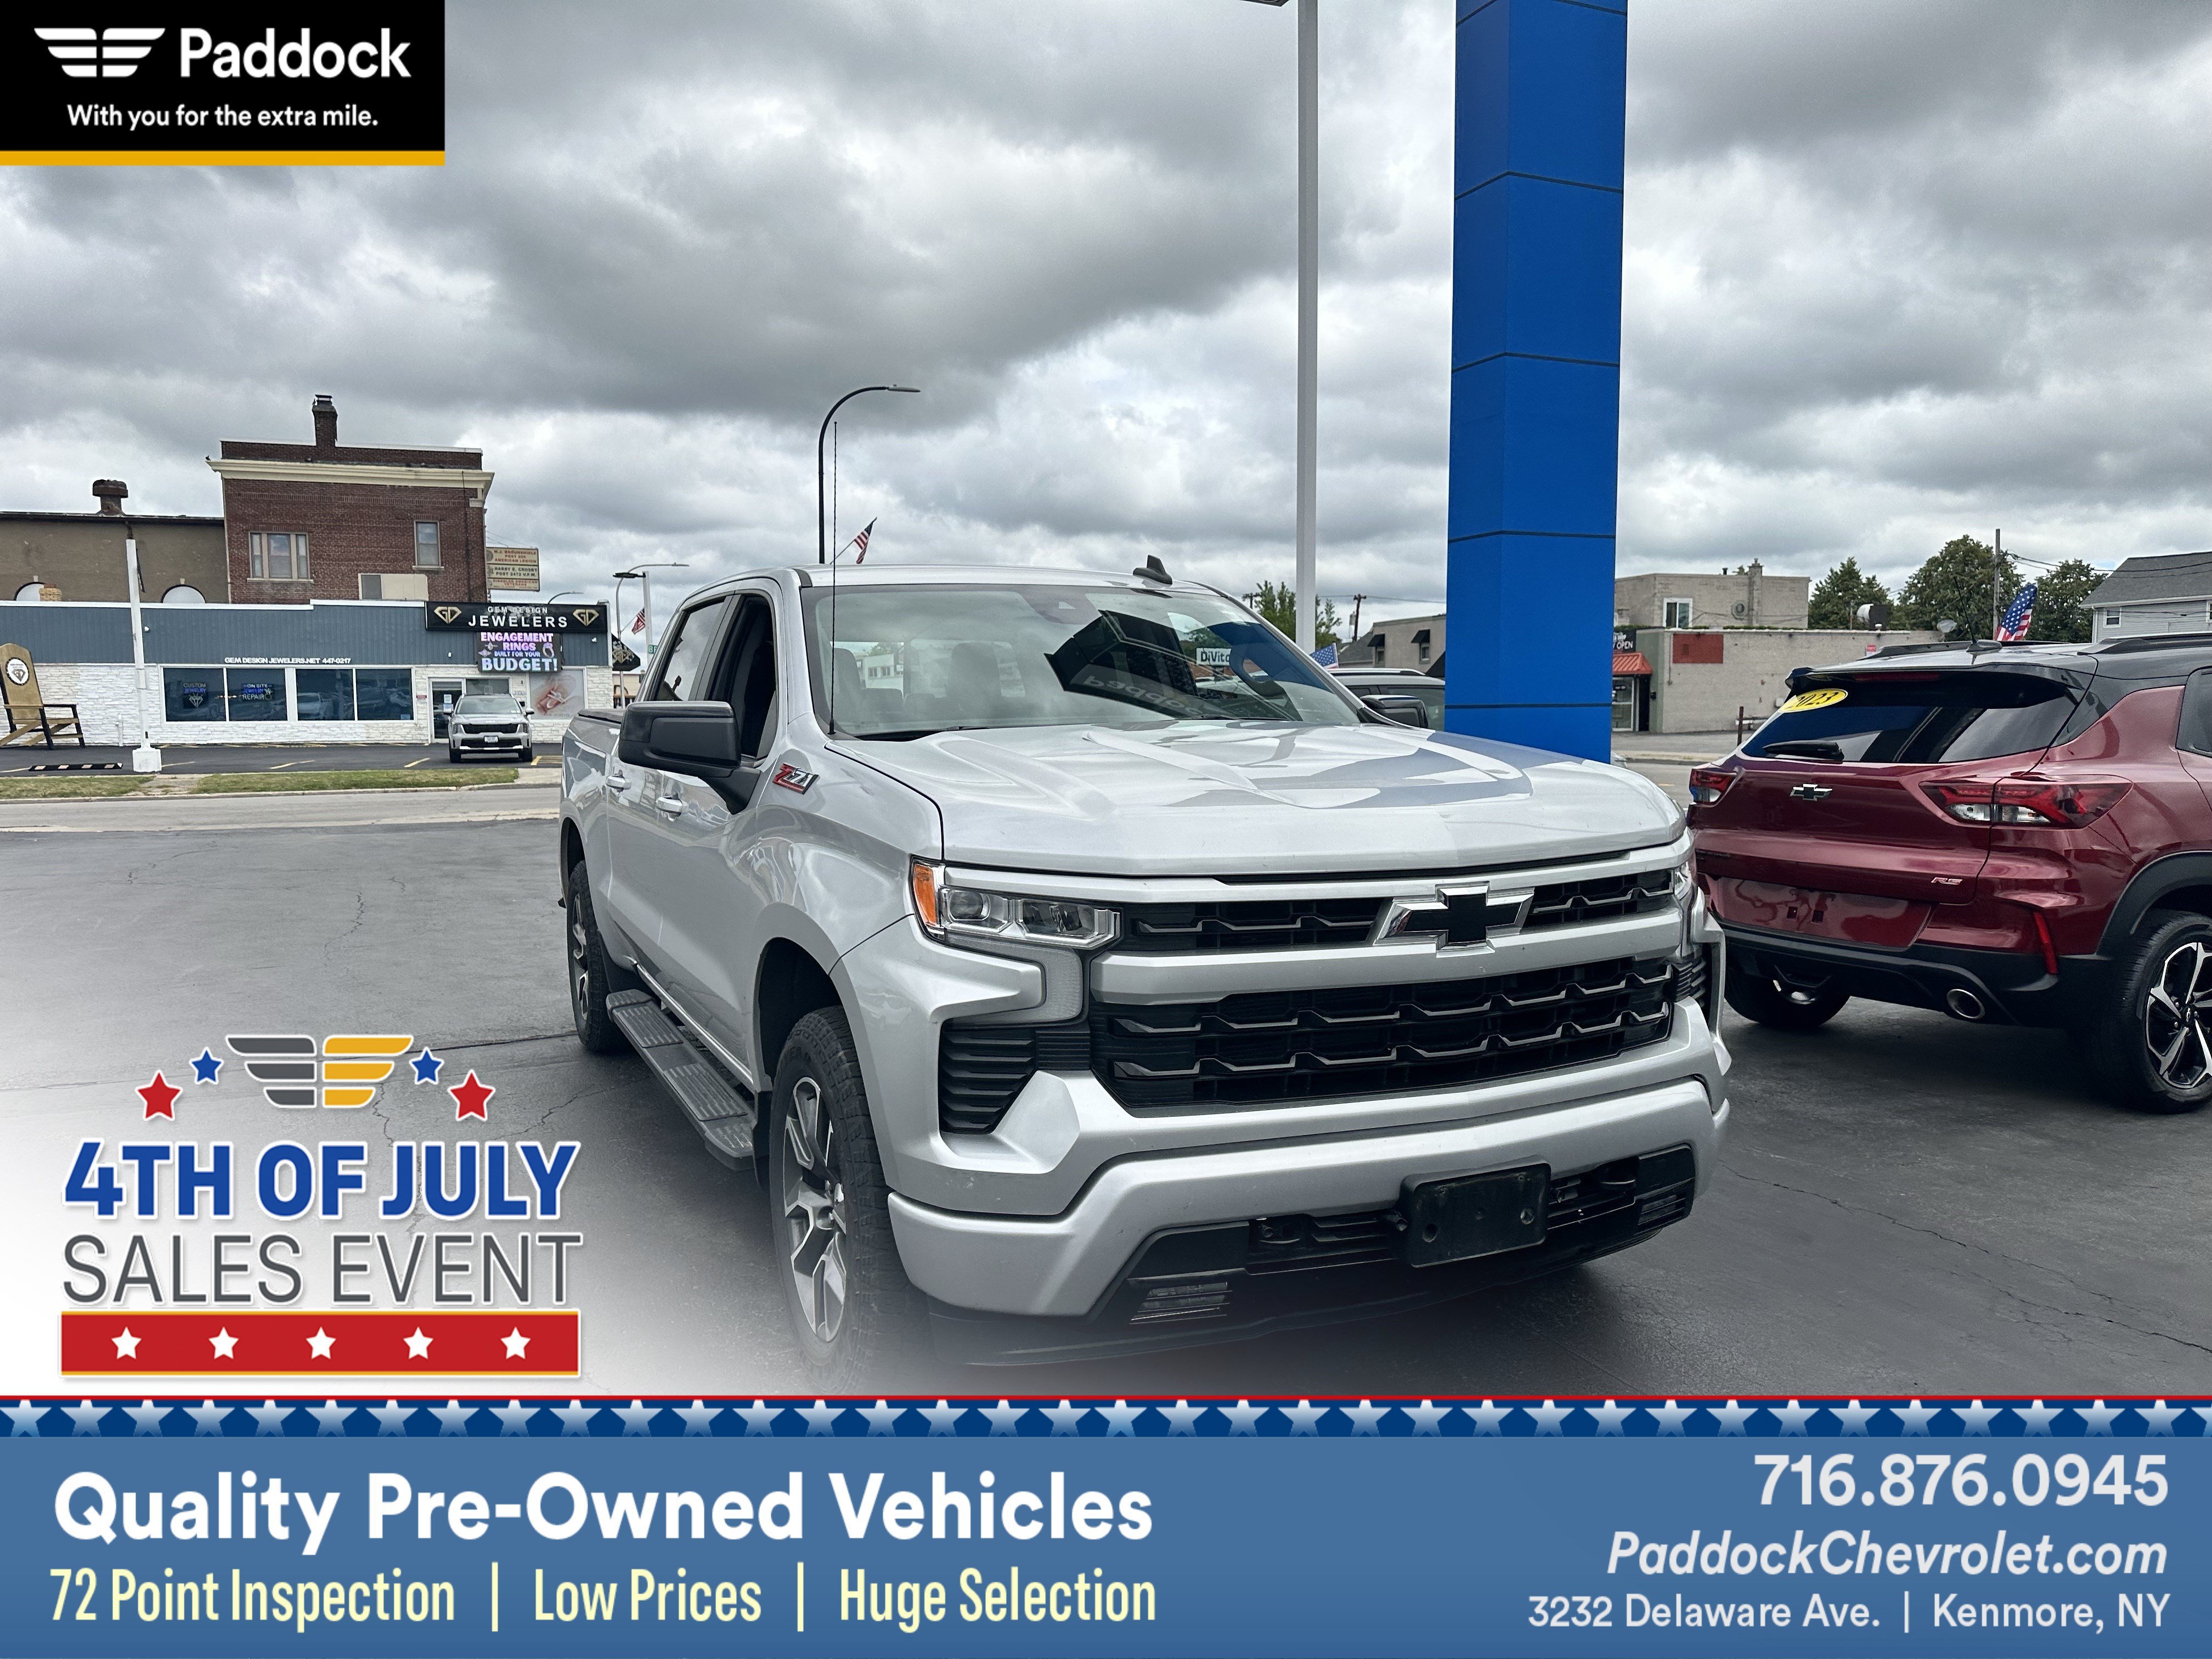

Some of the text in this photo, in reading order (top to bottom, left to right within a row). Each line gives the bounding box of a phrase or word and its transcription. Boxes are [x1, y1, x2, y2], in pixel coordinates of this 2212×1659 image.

[469, 615, 567, 628] JEWELERS
[481, 632, 554, 642] ENGAGEMENT
[503, 642, 537, 651] RINGS
[1616, 641, 1633, 650] OPEN
[482, 658, 557, 671] BUDGET!
[772, 763, 820, 794] Z71
[1931, 877, 1963, 885] RS
